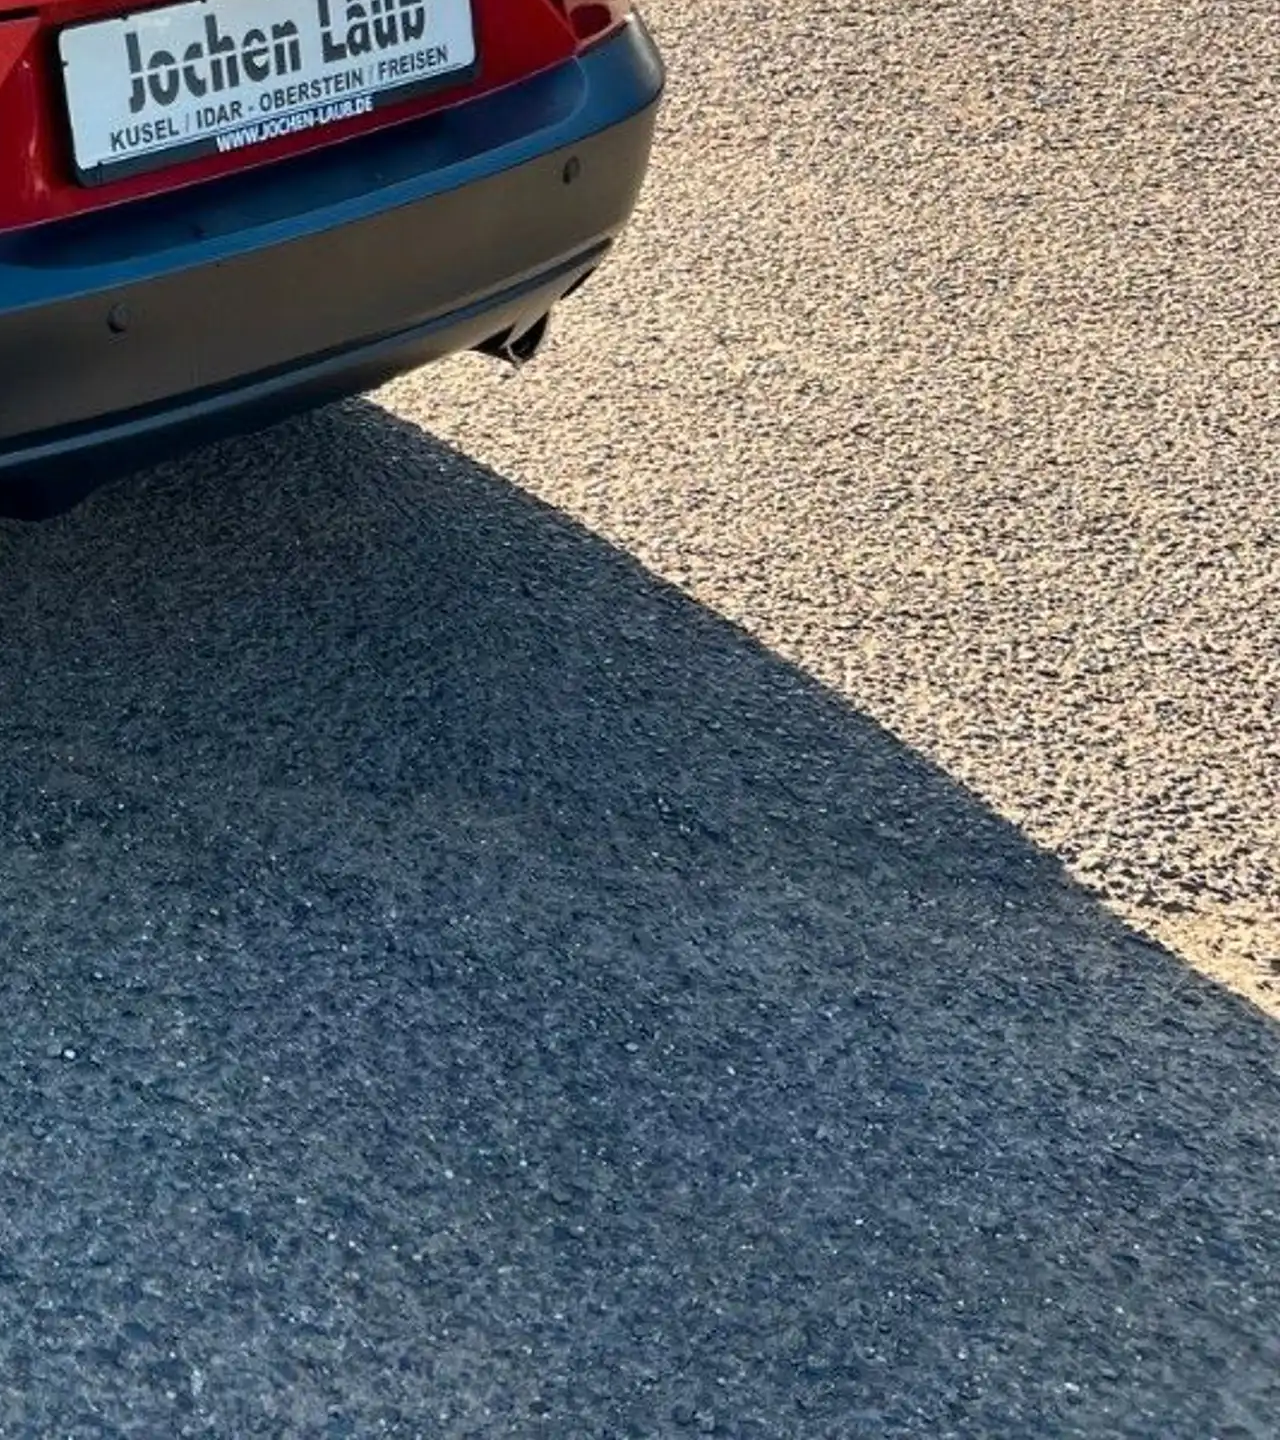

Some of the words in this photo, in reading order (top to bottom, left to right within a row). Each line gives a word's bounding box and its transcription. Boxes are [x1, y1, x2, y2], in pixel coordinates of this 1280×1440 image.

[110, 117, 179, 152] KUSEL
[196, 101, 243, 129] IDAR
[259, 68, 364, 113] OBERSTEIN
[378, 45, 448, 81] FREISEN
[125, 13, 302, 114] Jochen
[216, 95, 374, 152] WWW.JOCHEN-LAUB.DE
